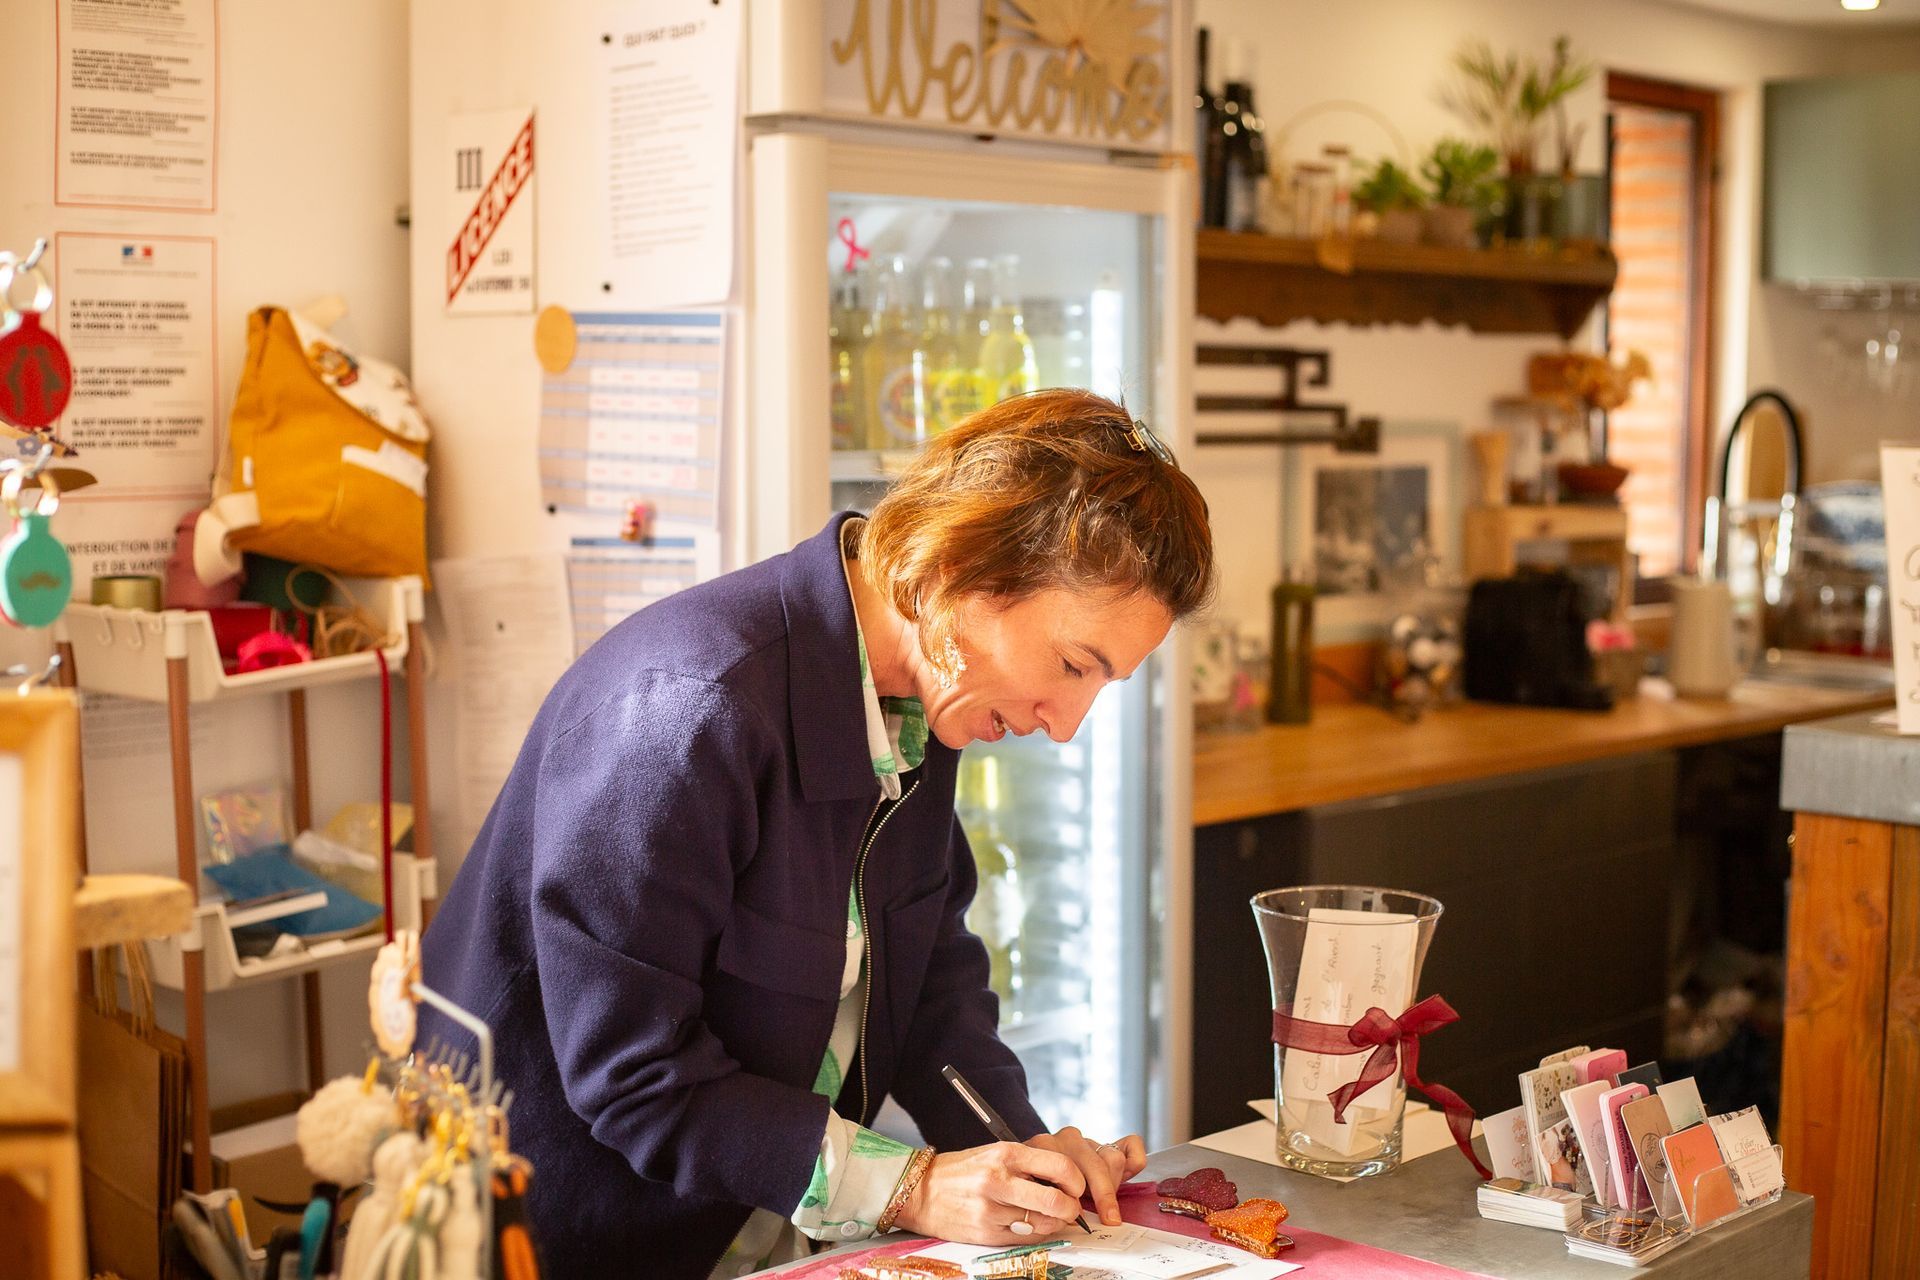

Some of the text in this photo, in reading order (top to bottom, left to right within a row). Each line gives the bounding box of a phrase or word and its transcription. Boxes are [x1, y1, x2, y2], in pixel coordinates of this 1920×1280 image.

[831, 0, 1170, 141] Welcome
[449, 114, 535, 302] LICENCE
[65, 540, 149, 555] NTERDICTION
